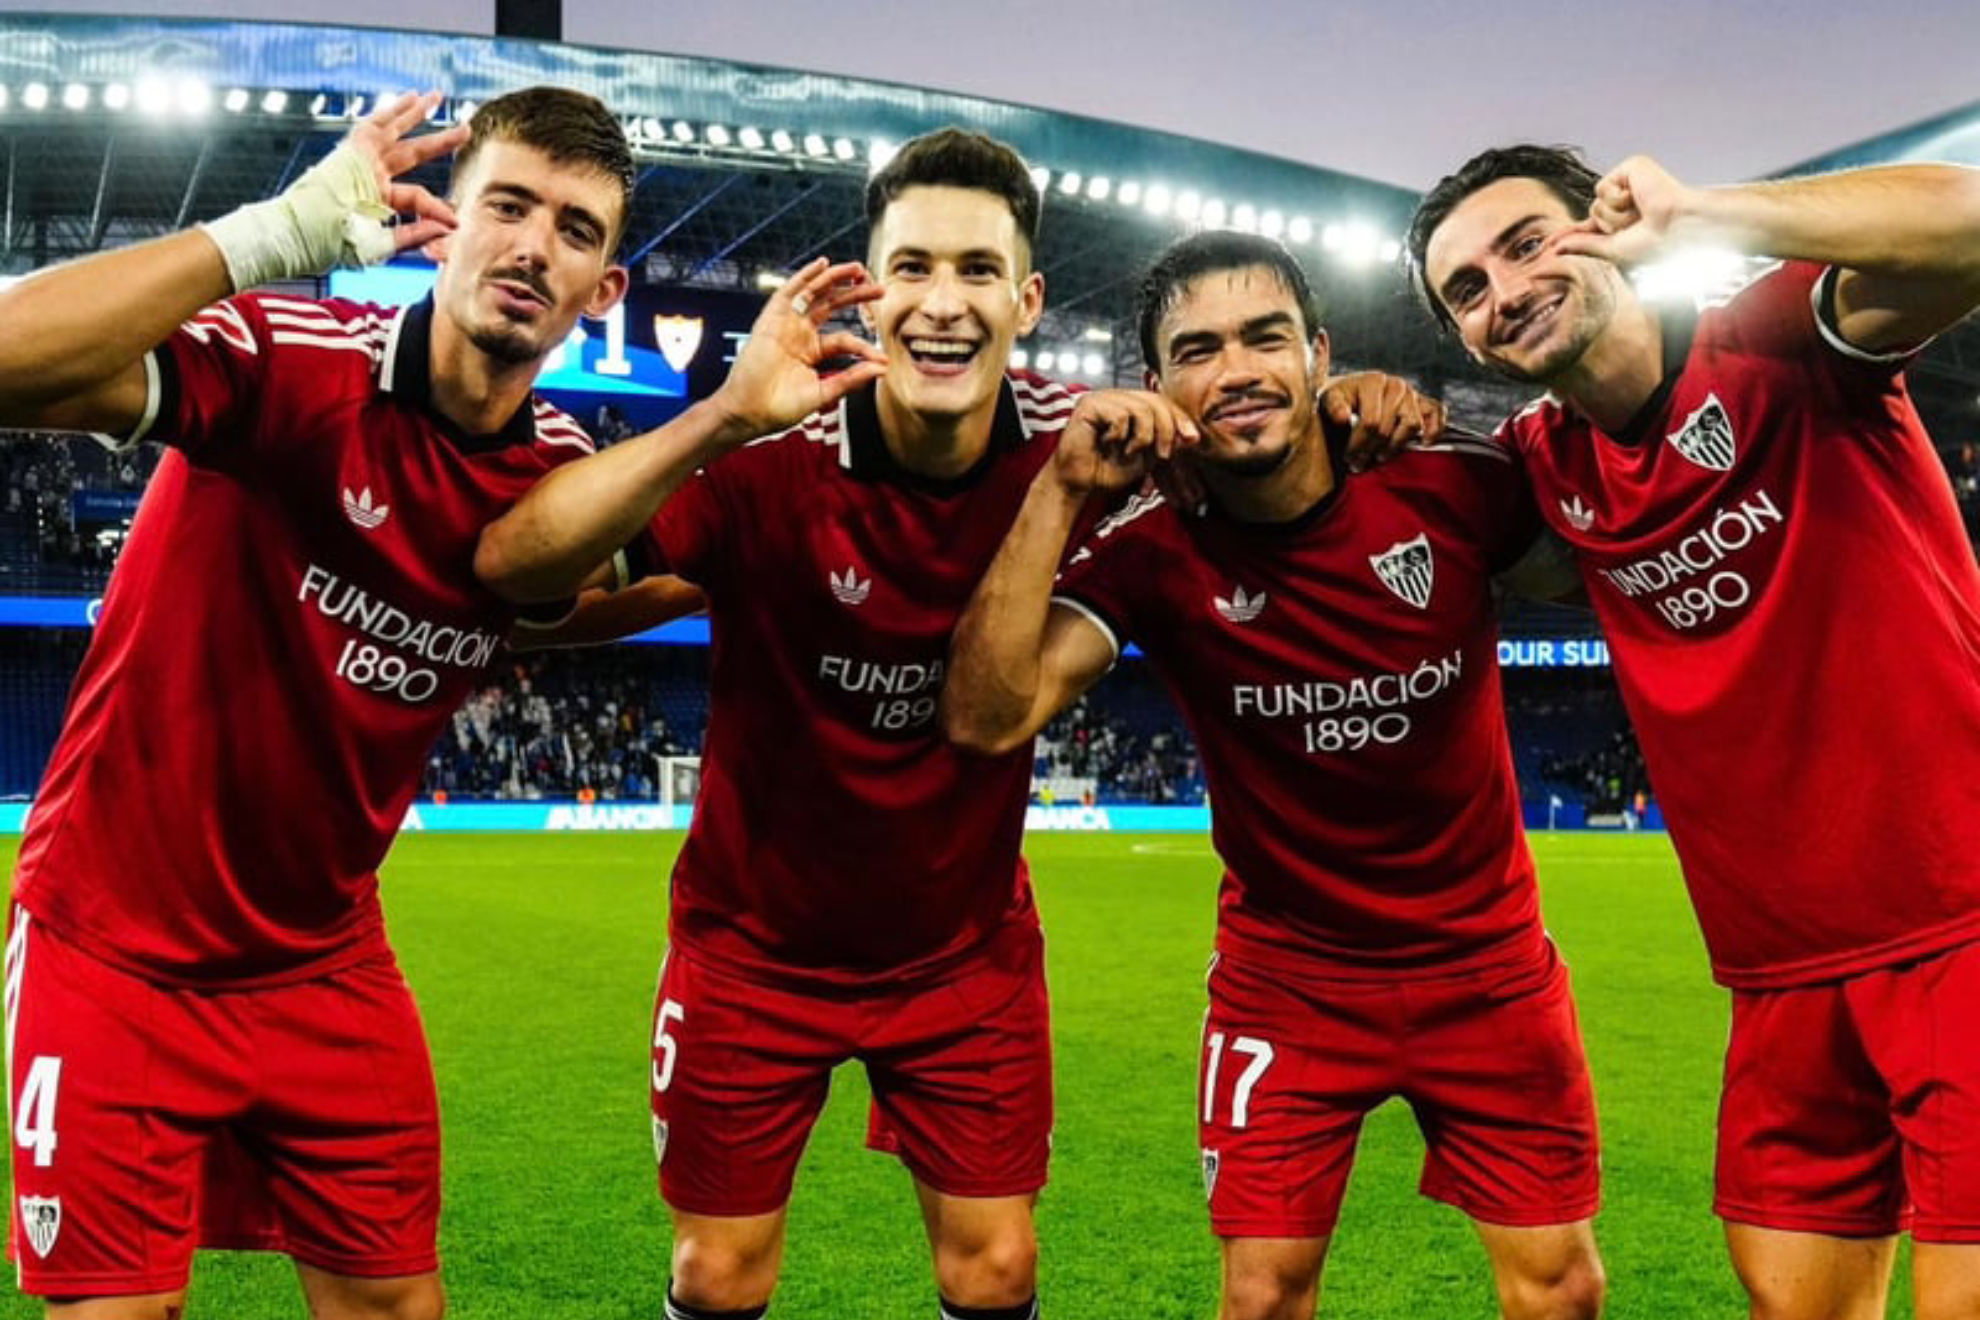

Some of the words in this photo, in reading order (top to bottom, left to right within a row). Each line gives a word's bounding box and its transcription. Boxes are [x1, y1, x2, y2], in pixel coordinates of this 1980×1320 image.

[297, 564, 499, 668] FUNDACIÓN
[1655, 571, 1750, 629] 1890
[336, 640, 438, 701] 1890
[1233, 649, 1462, 716] FUNDACIÓN
[1497, 640, 1555, 666] OUR
[1304, 712, 1410, 753] 1890
[652, 998, 684, 1092] 5
[14, 1055, 62, 1167] 4
[1203, 1032, 1274, 1128] 17
